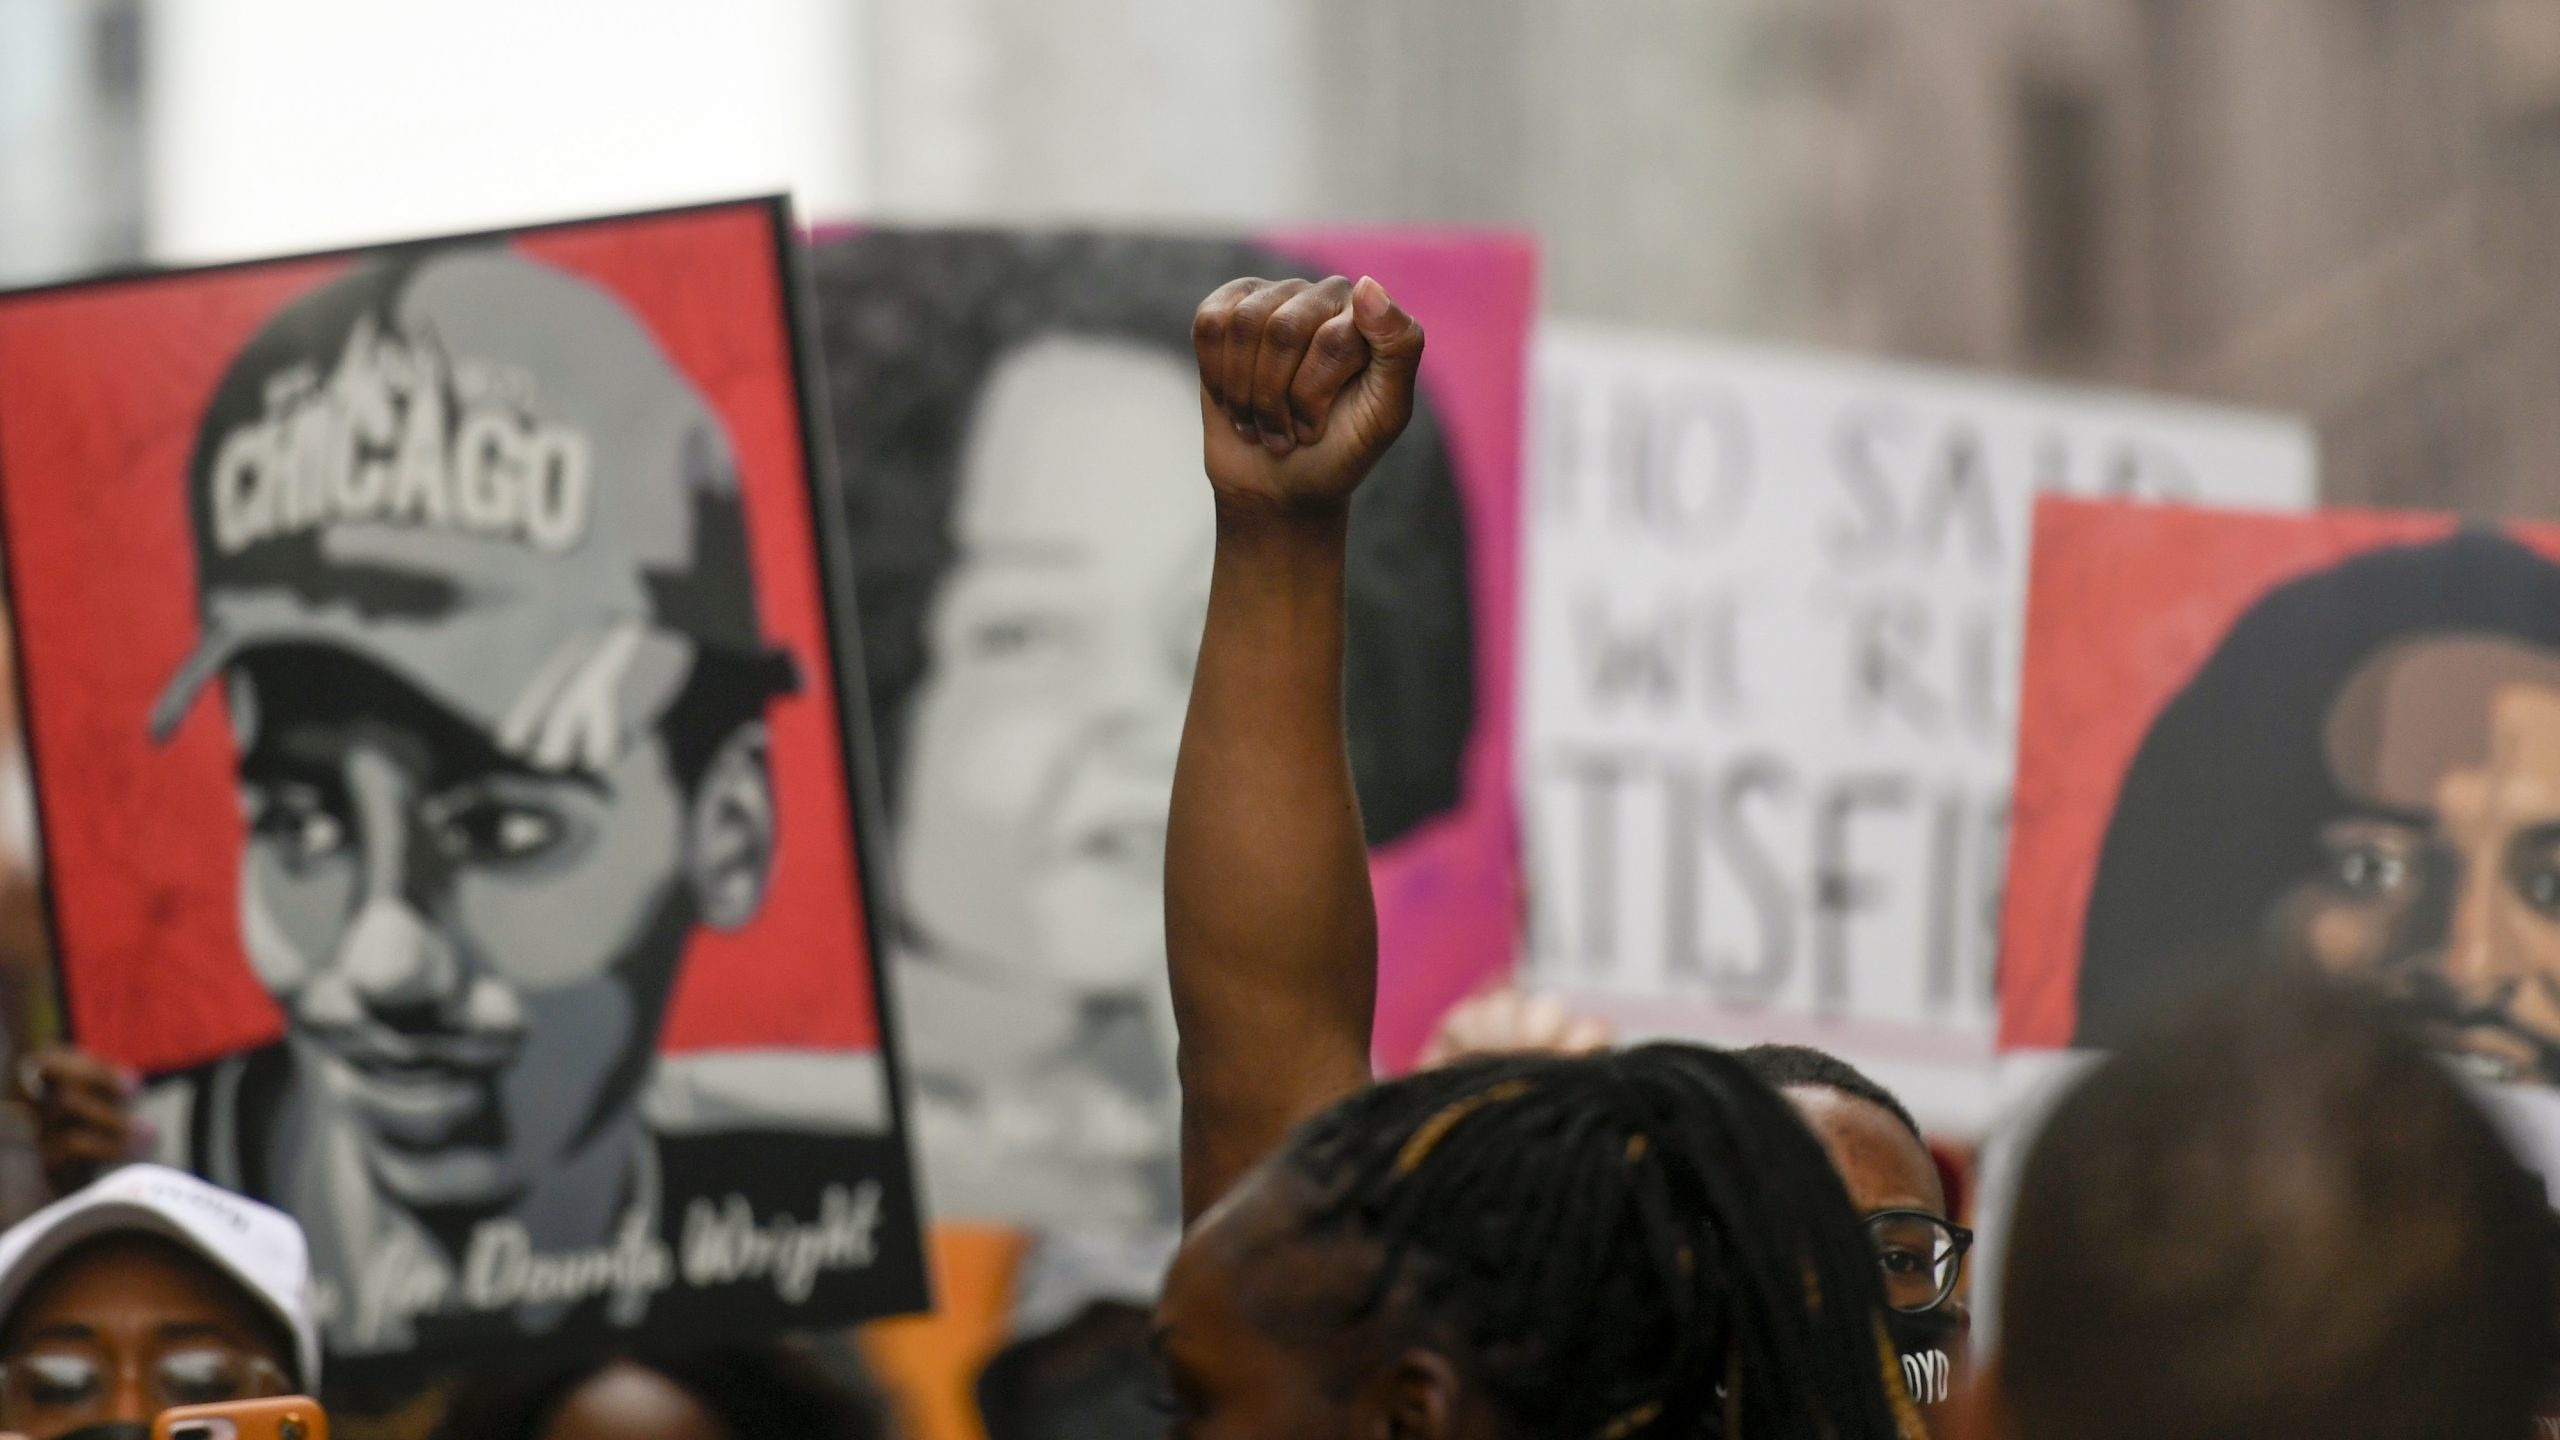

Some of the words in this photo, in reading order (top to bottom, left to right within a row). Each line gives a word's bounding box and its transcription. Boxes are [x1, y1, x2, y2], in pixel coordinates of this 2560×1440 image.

[213, 375, 588, 557] CHICAGO
[1530, 378, 1758, 555] HO
[1530, 745, 2010, 1018] TISFI
[1901, 1348, 1949, 1404] OYD
